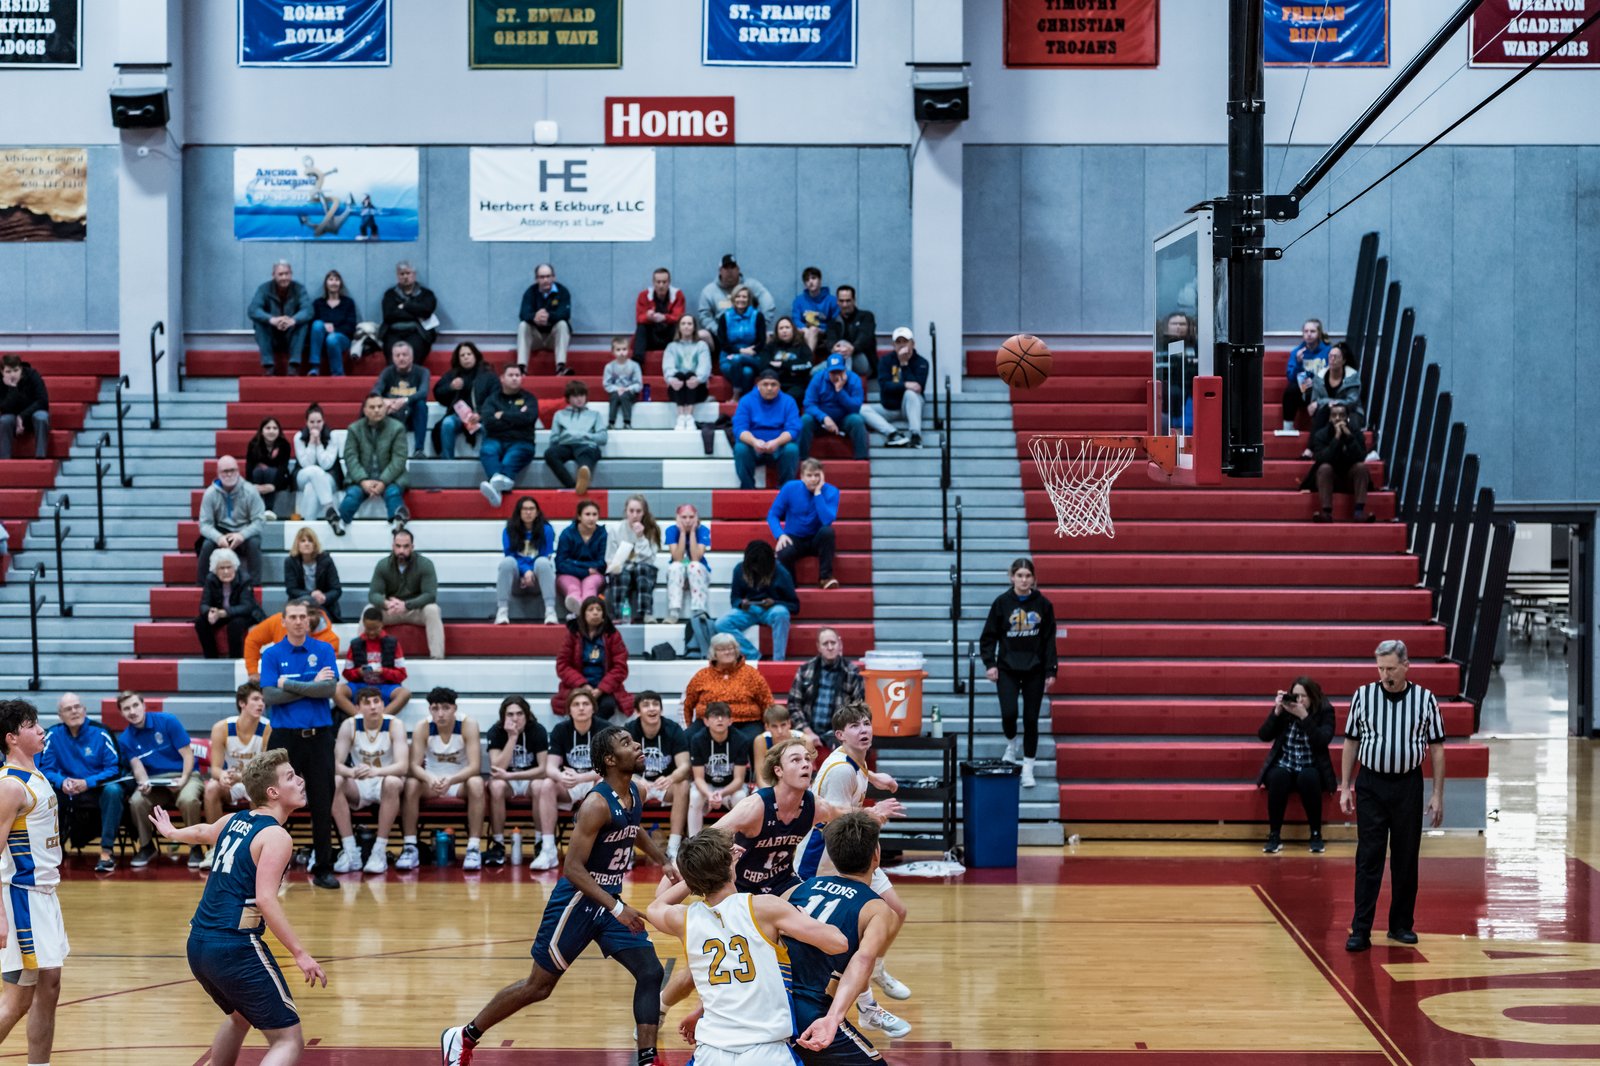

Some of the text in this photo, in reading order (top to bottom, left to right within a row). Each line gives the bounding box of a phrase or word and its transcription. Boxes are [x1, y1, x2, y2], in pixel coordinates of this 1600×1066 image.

[283, 5, 346, 21] ROSARY
[729, 4, 831, 20] ST. FRANCIS
[1045, 0, 1118, 10] TIMOTHY
[1507, 0, 1585, 11] WHEATON
[496, 8, 596, 23] ST. EDWARD
[1282, 6, 1345, 21] FENTON
[1037, 18, 1126, 32] CHRISTIAN
[1507, 18, 1585, 34] ACADEMY
[285, 28, 345, 43] ROYALS
[494, 30, 598, 45] GREEN WAVE
[738, 27, 821, 43] SPARTANS
[1289, 28, 1338, 42] BISON
[1046, 40, 1117, 54] TROJANS
[1503, 40, 1589, 56] WARRIORS
[612, 103, 728, 137] Home
[263, 179, 317, 187] PLUMBING
[539, 160, 588, 193] HE
[480, 201, 645, 214] Herbert & Eckburg, LLC
[520, 217, 604, 228] Attorneys at Law
[888, 681, 905, 701] G
[212, 835, 243, 874] 24
[608, 847, 631, 870] 23
[810, 880, 858, 899] LIONS
[803, 894, 841, 924] 11
[702, 934, 756, 985] 23
